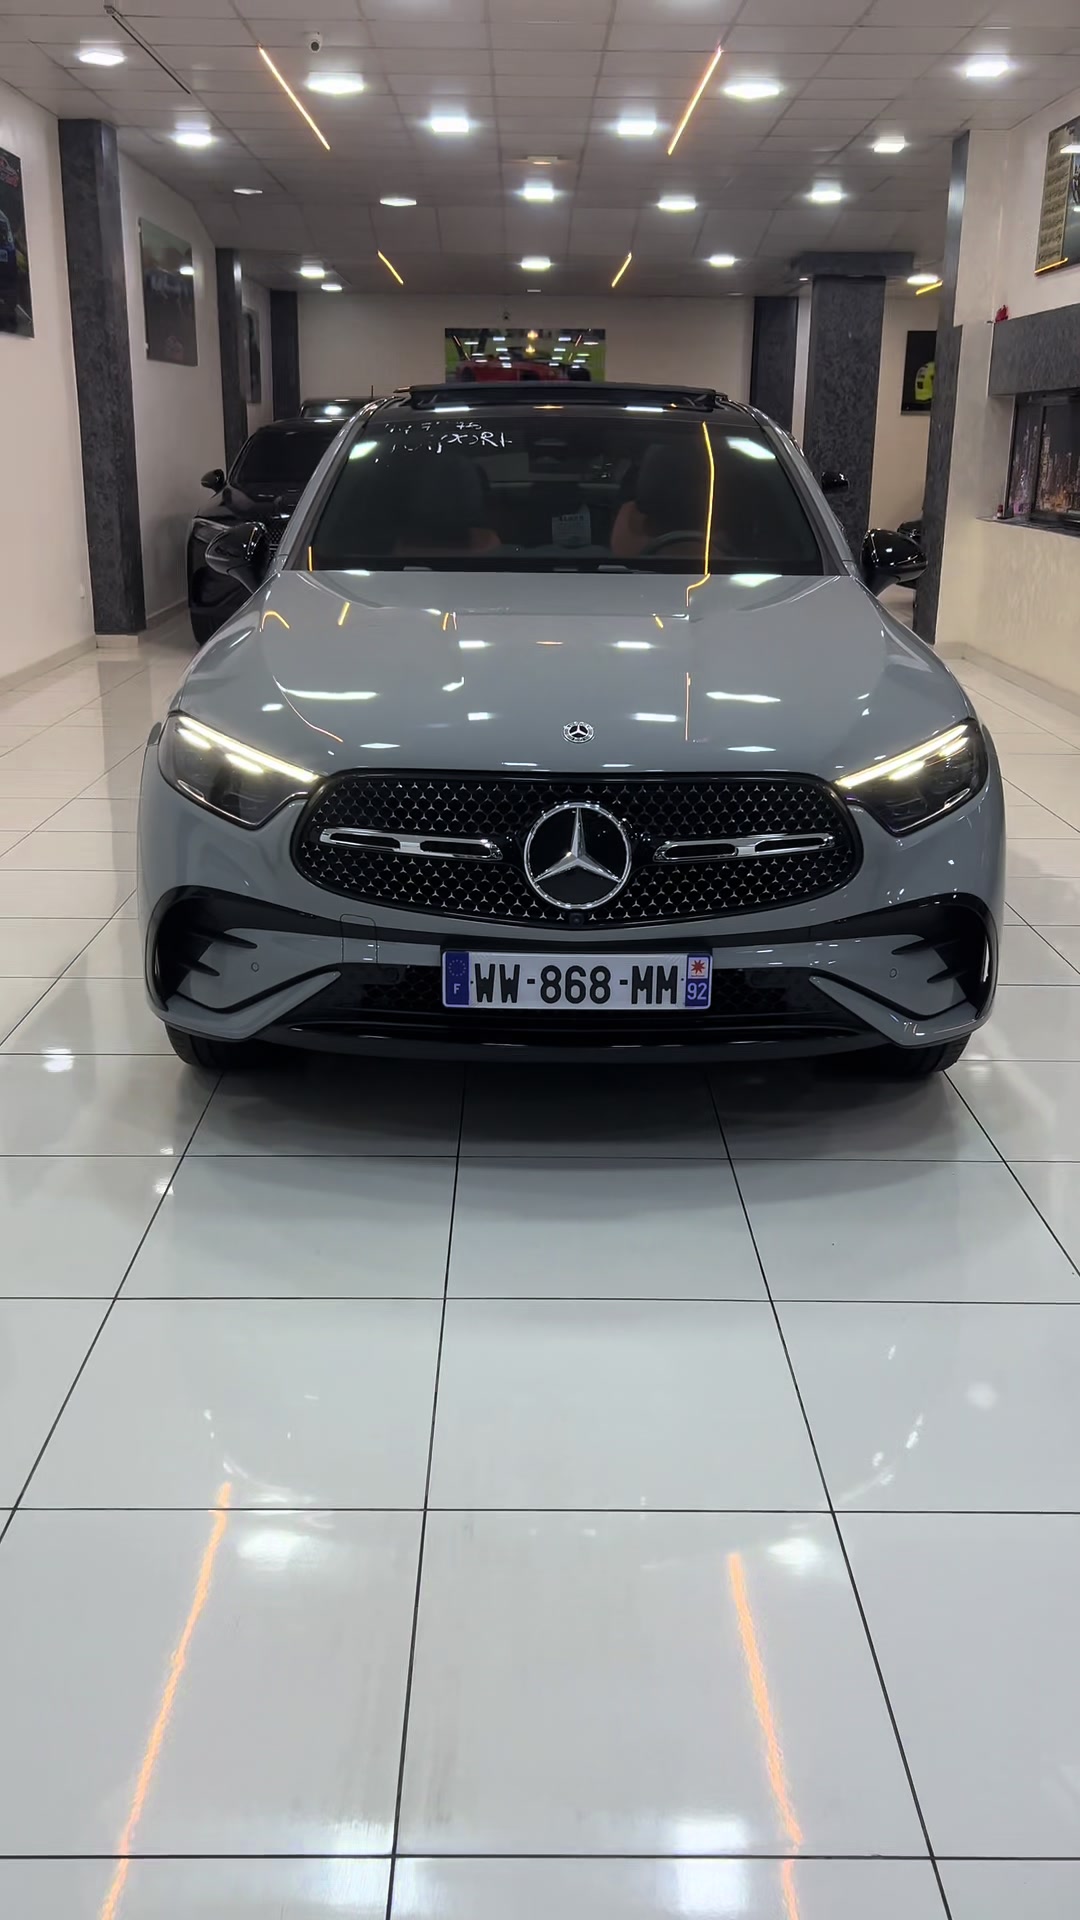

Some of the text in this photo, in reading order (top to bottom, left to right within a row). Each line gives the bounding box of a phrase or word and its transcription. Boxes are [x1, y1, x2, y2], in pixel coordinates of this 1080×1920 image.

[453, 983, 462, 995] F
[474, 963, 678, 1005] WW-868-MM
[687, 982, 708, 1000] 92
